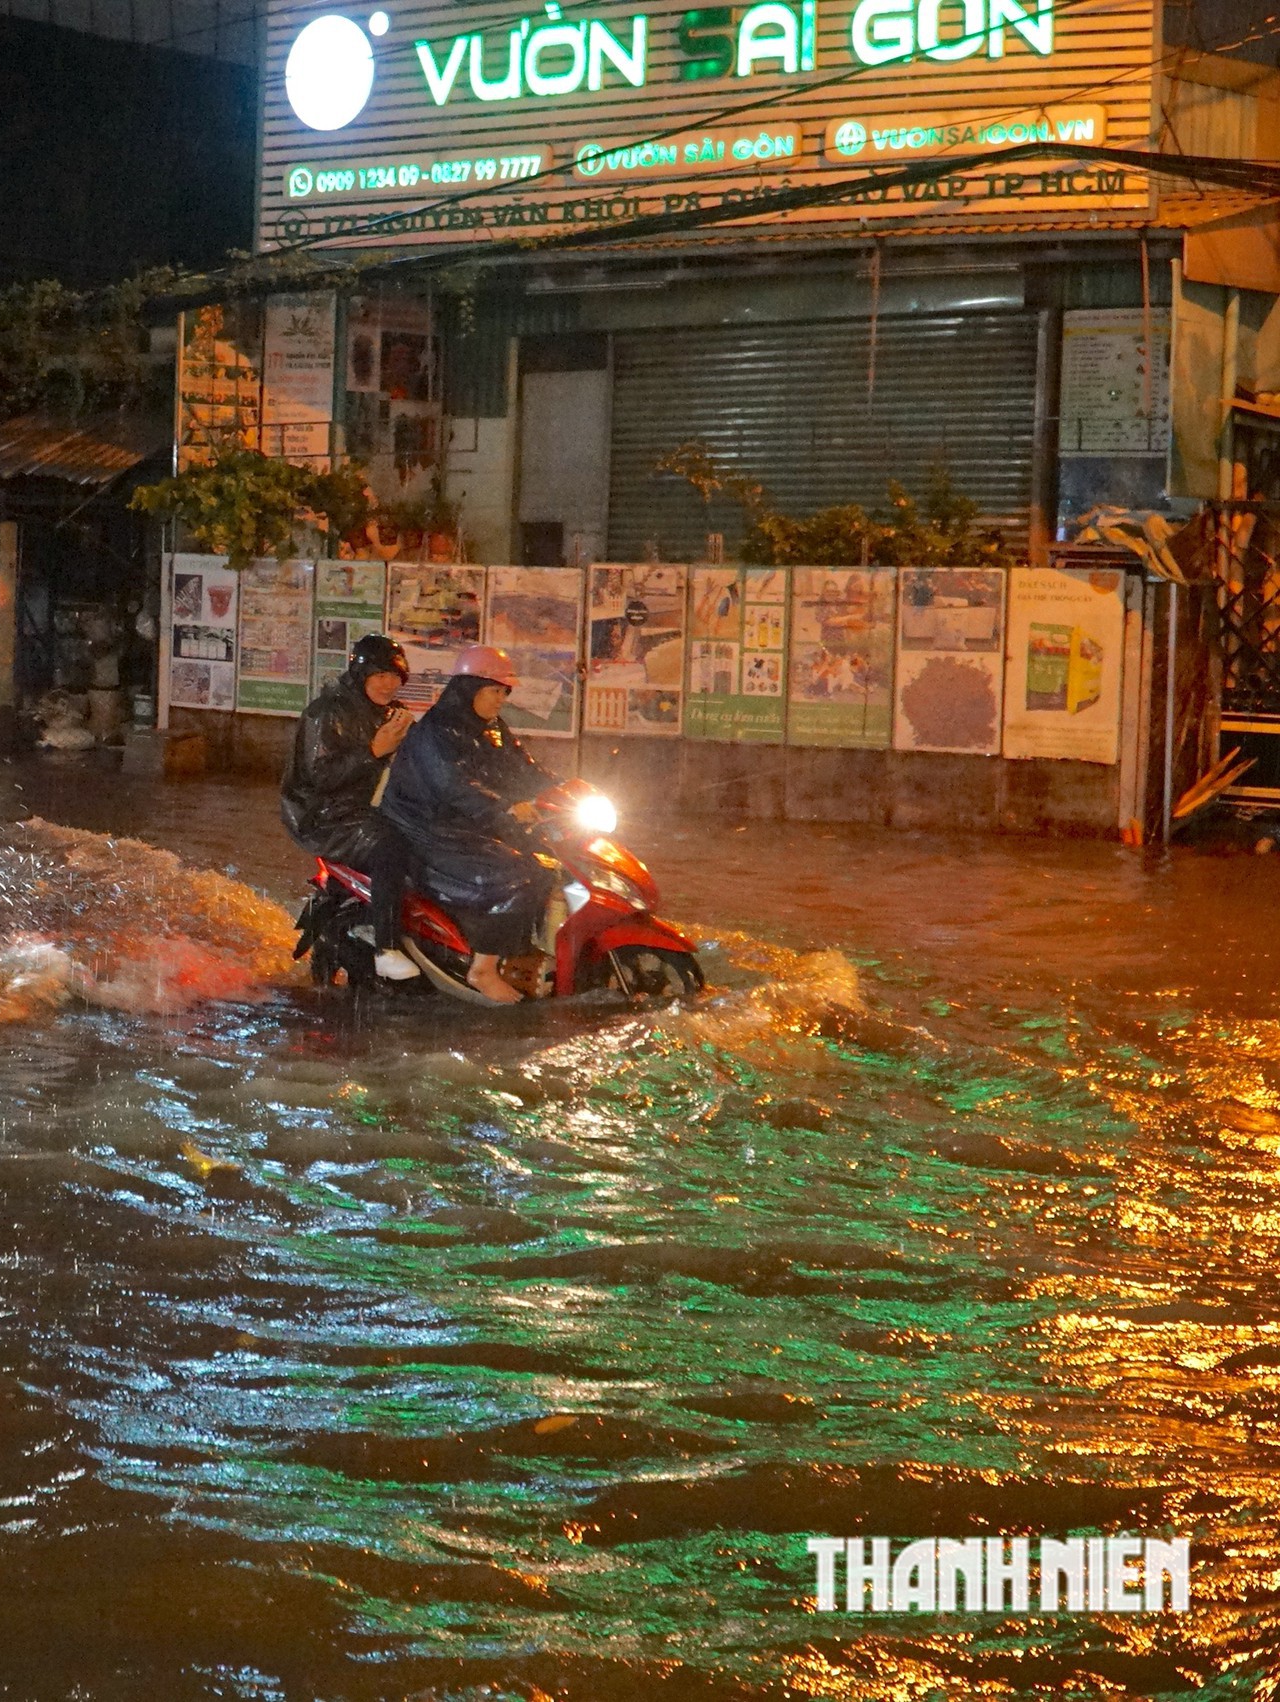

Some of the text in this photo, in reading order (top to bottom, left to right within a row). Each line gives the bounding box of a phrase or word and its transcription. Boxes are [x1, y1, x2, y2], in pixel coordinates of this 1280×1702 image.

[415, 1, 648, 106] VƯỜN
[316, 169, 355, 193] 0909
[358, 165, 397, 190] 1234
[399, 163, 420, 187] 09
[474, 157, 497, 181] 99
[500, 155, 542, 179] 7777
[1039, 168, 1125, 196] HCM
